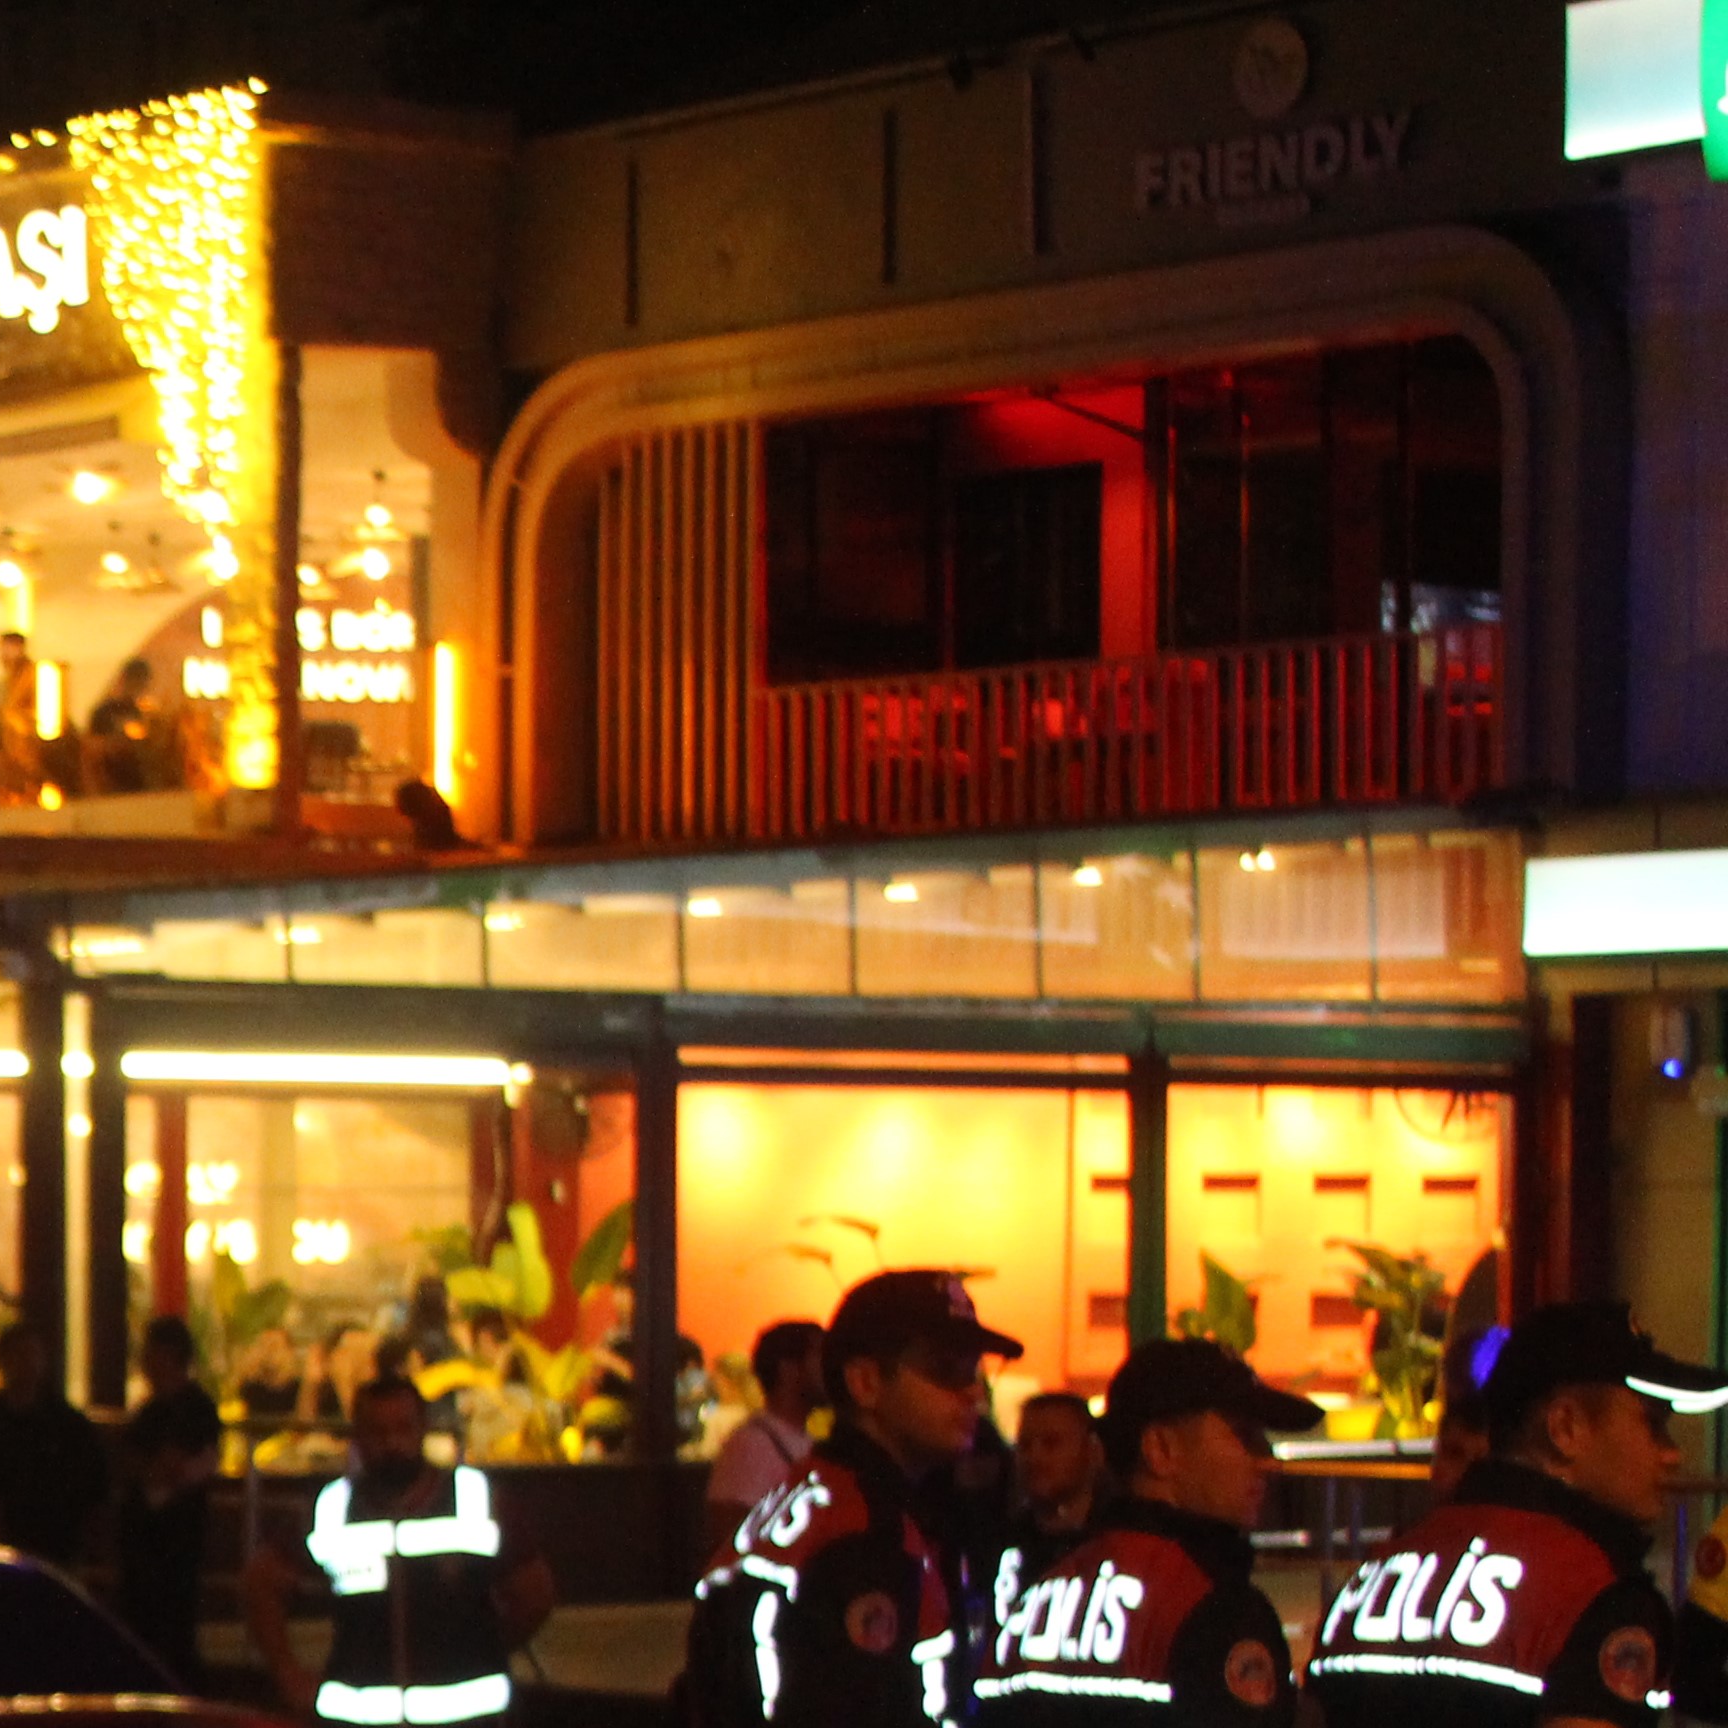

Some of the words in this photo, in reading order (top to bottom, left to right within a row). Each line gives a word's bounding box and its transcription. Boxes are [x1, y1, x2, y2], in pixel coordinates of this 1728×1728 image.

[1134, 108, 1410, 210] FRIENDLY
[996, 1559, 1145, 1666] POLİS
[1322, 1536, 1525, 1647] POLİS
